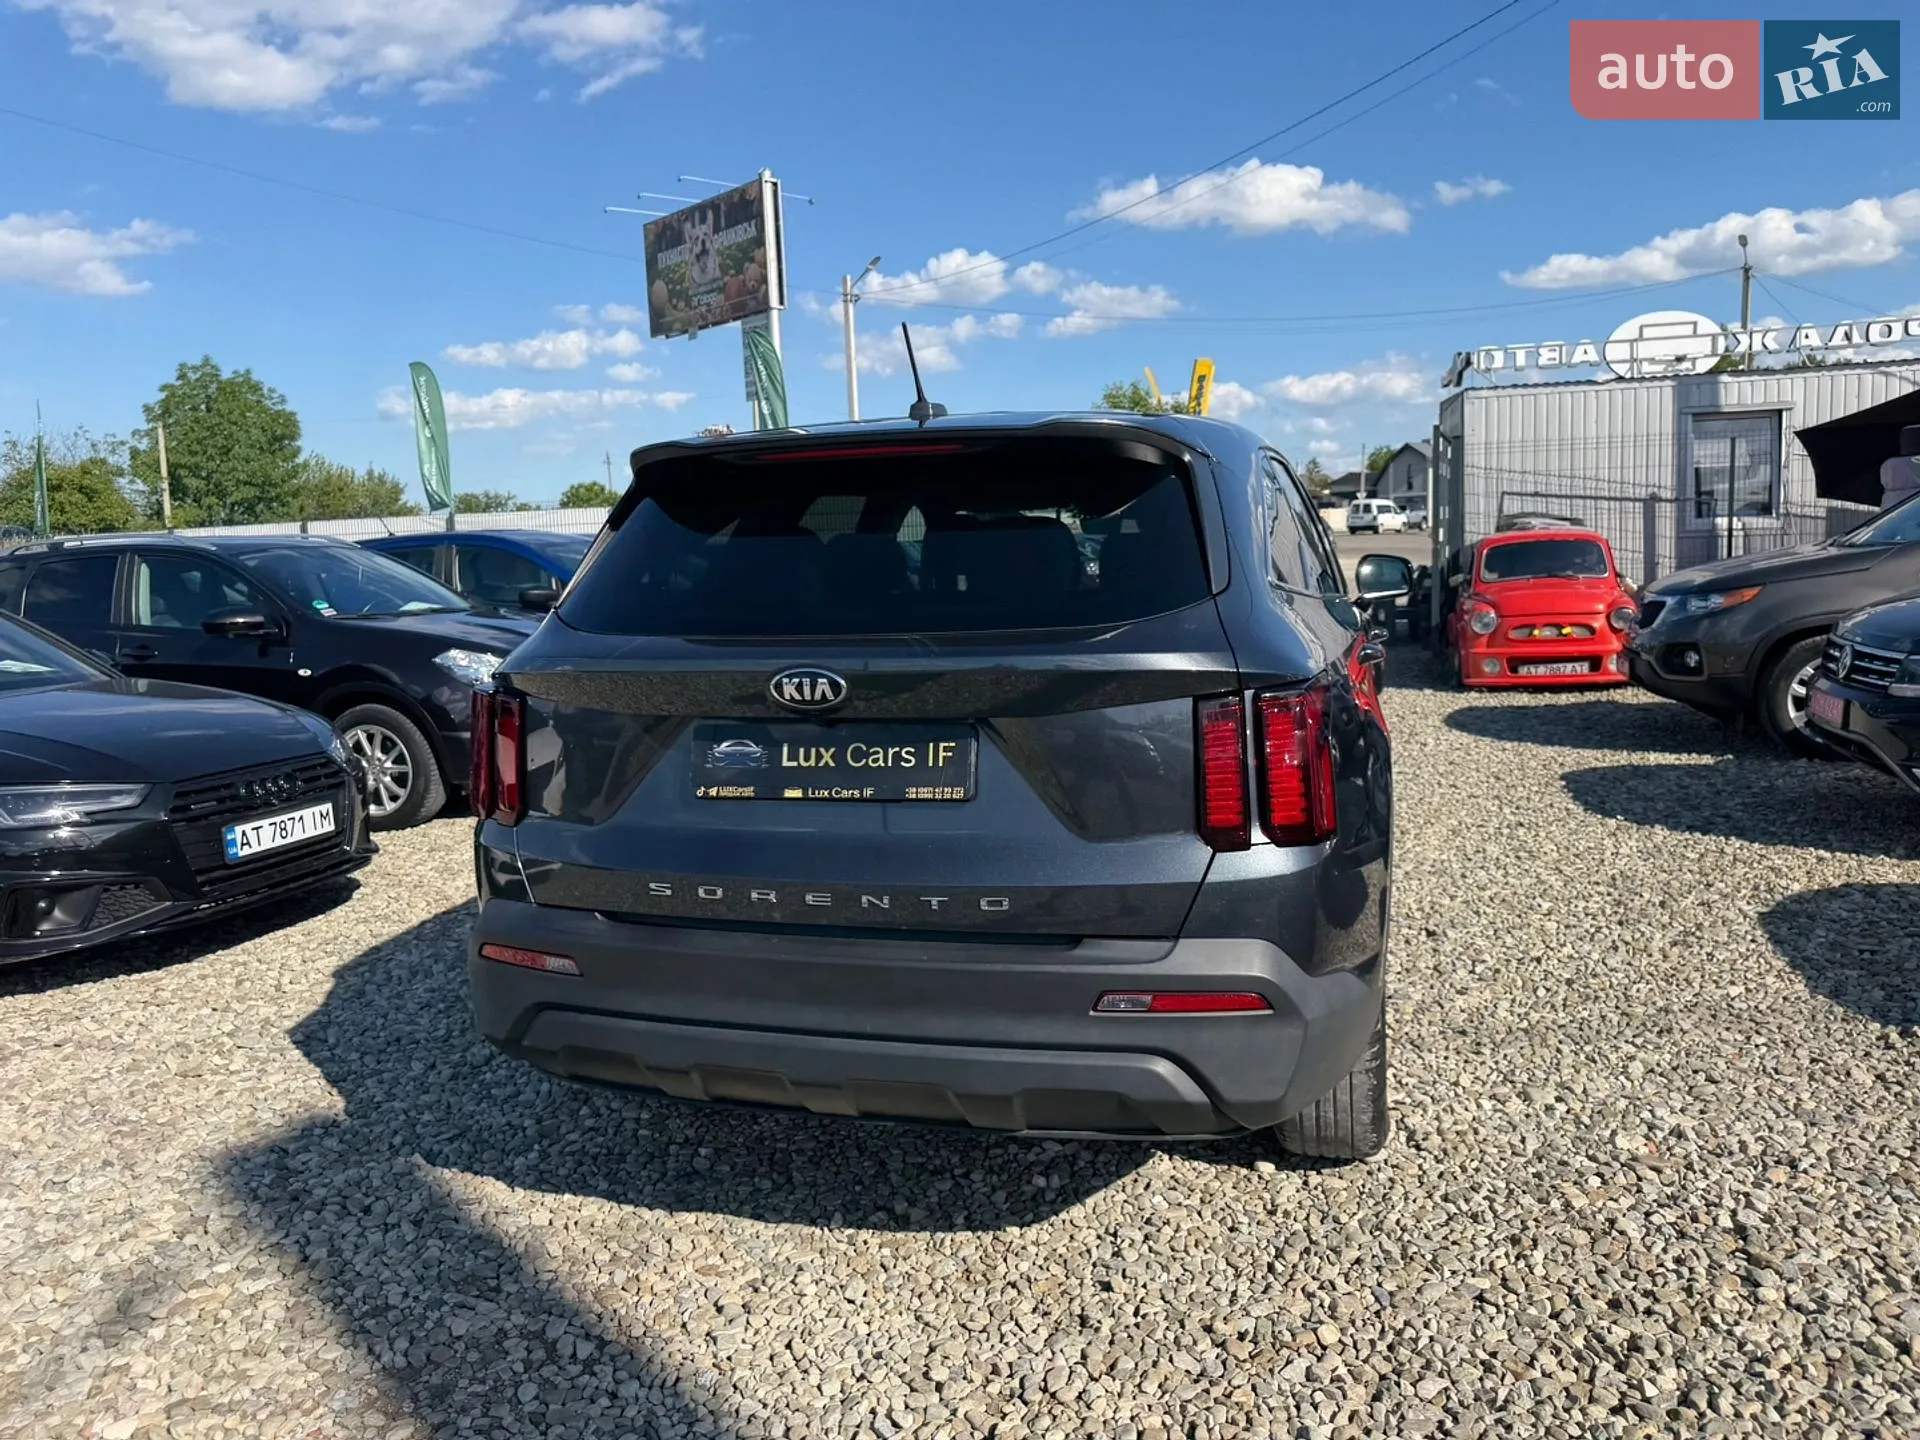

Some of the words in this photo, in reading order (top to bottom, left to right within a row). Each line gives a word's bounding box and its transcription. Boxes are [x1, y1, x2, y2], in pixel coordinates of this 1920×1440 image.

[782, 678, 835, 700] KIA
[781, 742, 836, 767] Lux
[846, 742, 916, 767] Cars
[927, 742, 956, 767] IF
[808, 788, 829, 798] Lux
[832, 787, 860, 798] Cars
[863, 787, 875, 798] IF
[240, 825, 264, 851] AT
[268, 815, 306, 843] 7871
[312, 807, 332, 831] IM
[649, 882, 1009, 911] SORENTO
